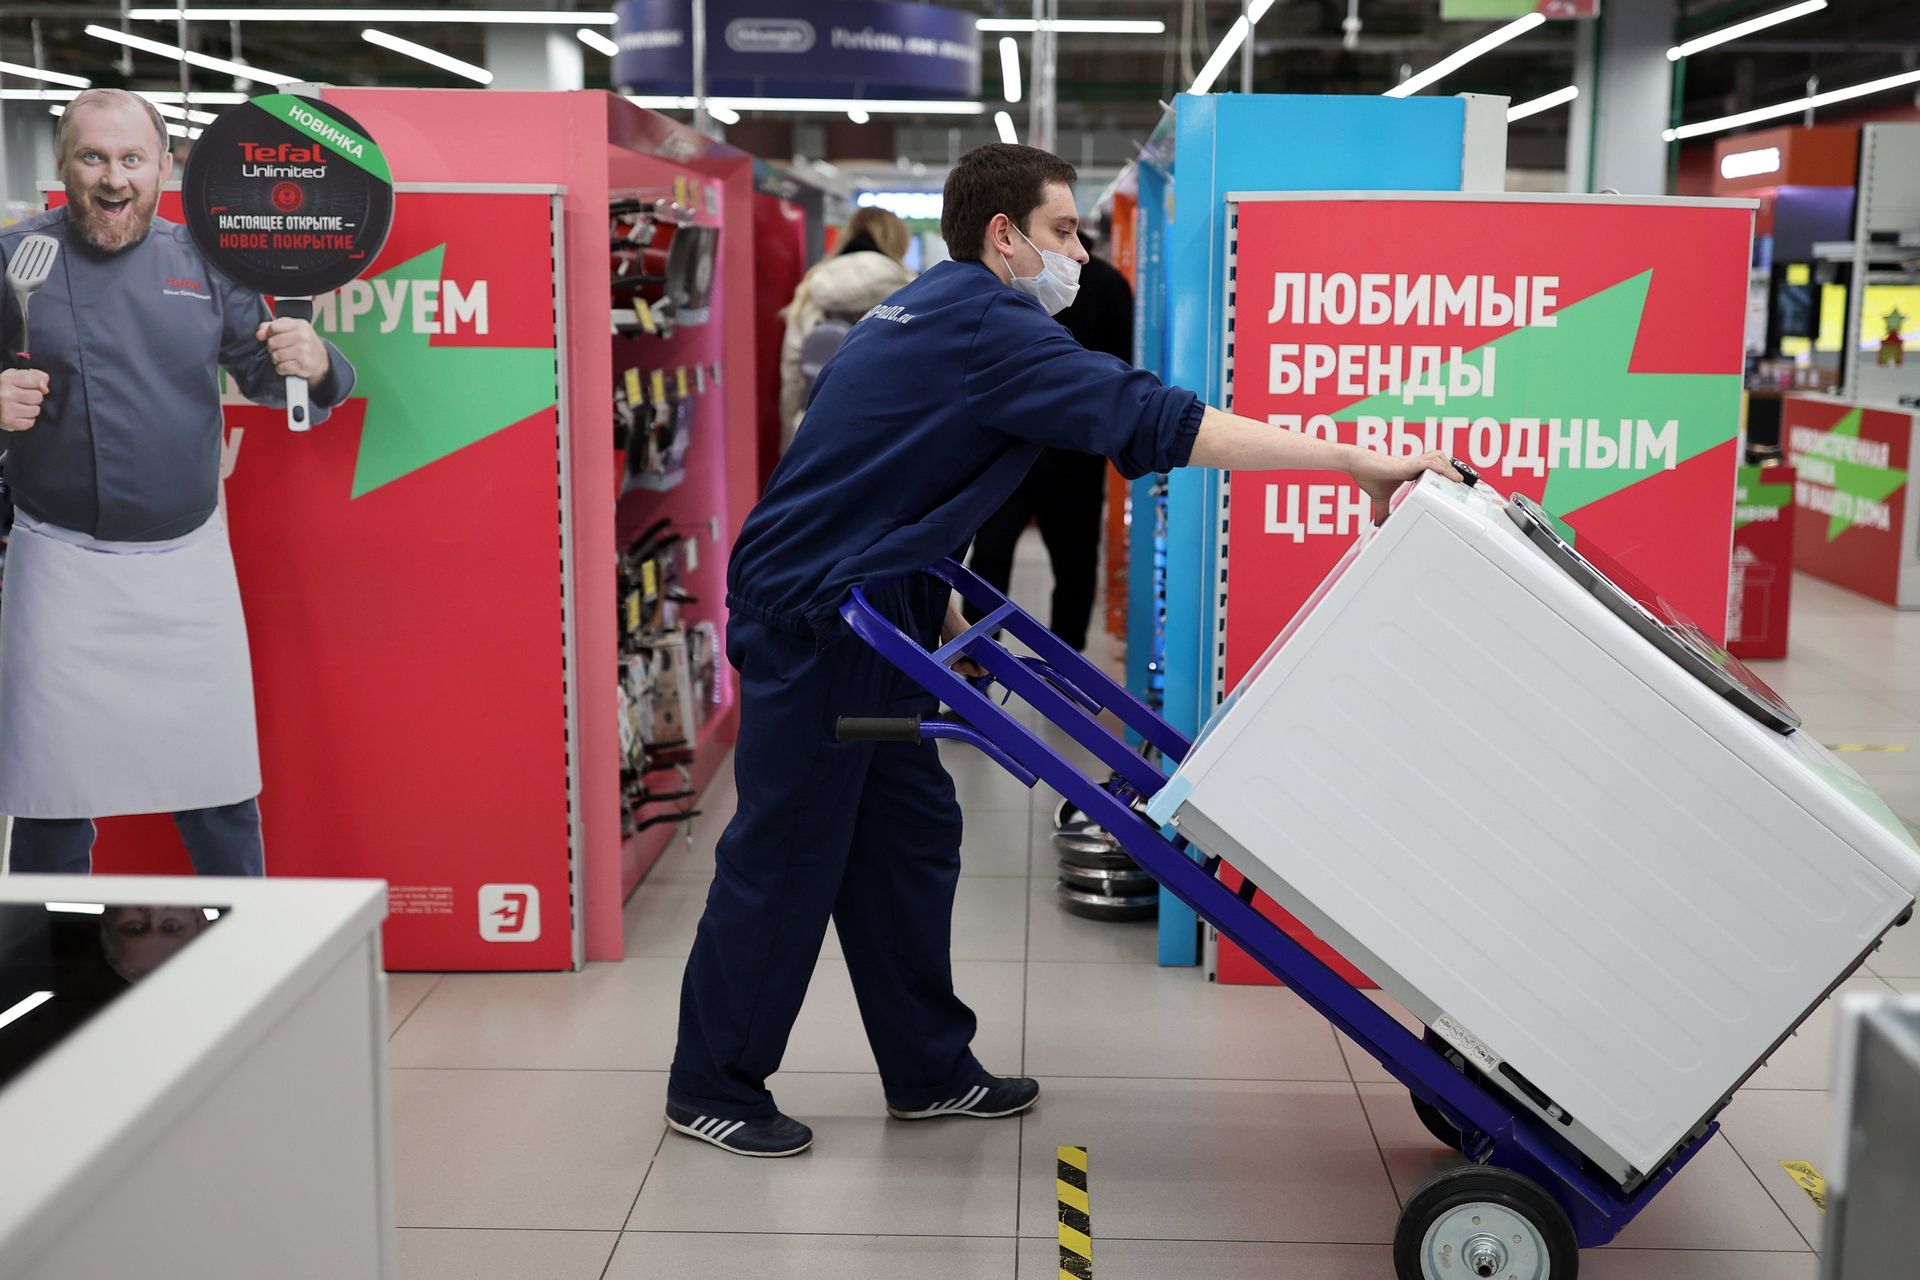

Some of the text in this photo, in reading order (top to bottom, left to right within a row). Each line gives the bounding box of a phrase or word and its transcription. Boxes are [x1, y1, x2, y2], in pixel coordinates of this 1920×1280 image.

[238, 142, 328, 164] Tefal
[288, 104, 364, 159] НОВИНКА
[241, 164, 327, 179] Unlimited
[219, 215, 343, 232] НАСТОЯЩЕЕ ОТКРЫТИЕ
[219, 233, 354, 250] НОВОЕ ПОКРЫТИЕ
[1268, 272, 1560, 328] ЛЮБИМЫЕ
[1268, 343, 1497, 405] БРЕНДЫ
[1356, 415, 1680, 478] ВЫГОДНЫМ
[1264, 483, 1373, 543] ЦЕН
